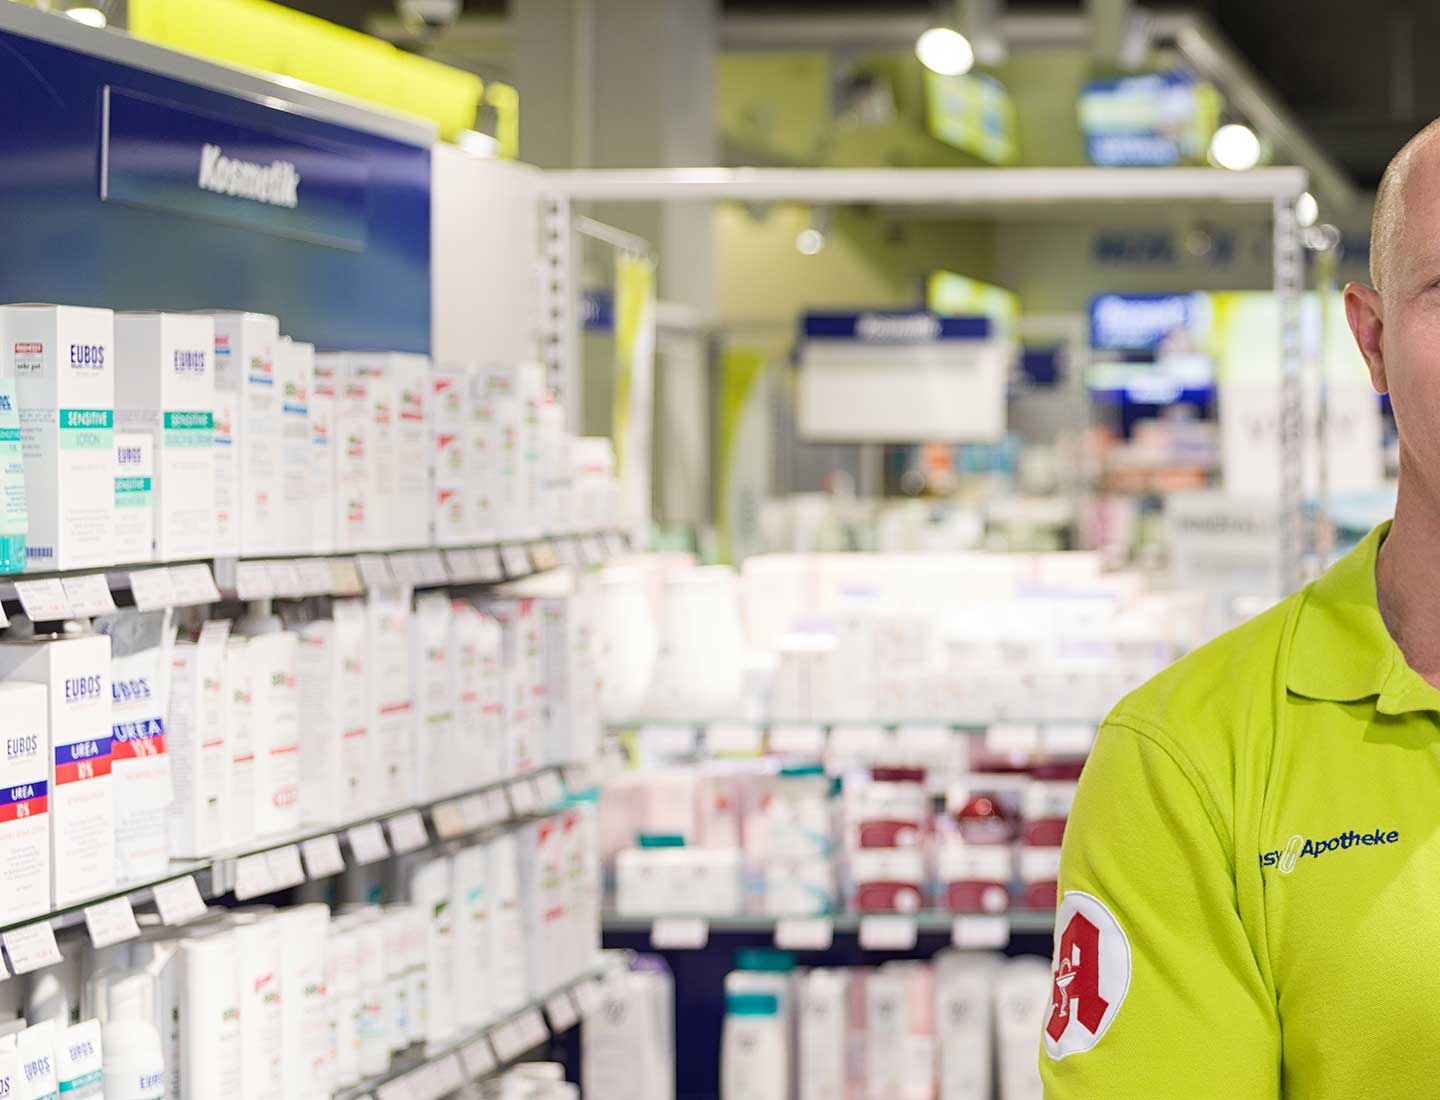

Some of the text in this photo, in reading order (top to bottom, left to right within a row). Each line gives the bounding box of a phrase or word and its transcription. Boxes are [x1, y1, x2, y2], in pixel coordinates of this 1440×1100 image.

[199, 143, 301, 208] Kosmetik
[70, 344, 105, 364] EUBOS
[68, 411, 107, 426] SENSITIVE
[65, 675, 101, 698] EUBOS
[115, 720, 160, 742] UREA
[8, 736, 37, 755] EUBOS
[71, 741, 99, 760] UREA
[77, 762, 94, 779] 10%
[11, 785, 34, 801] UREA
[16, 802, 30, 818] 10%
[1300, 829, 1399, 858] Apotheke
[24, 1056, 50, 1081] EUBOS
